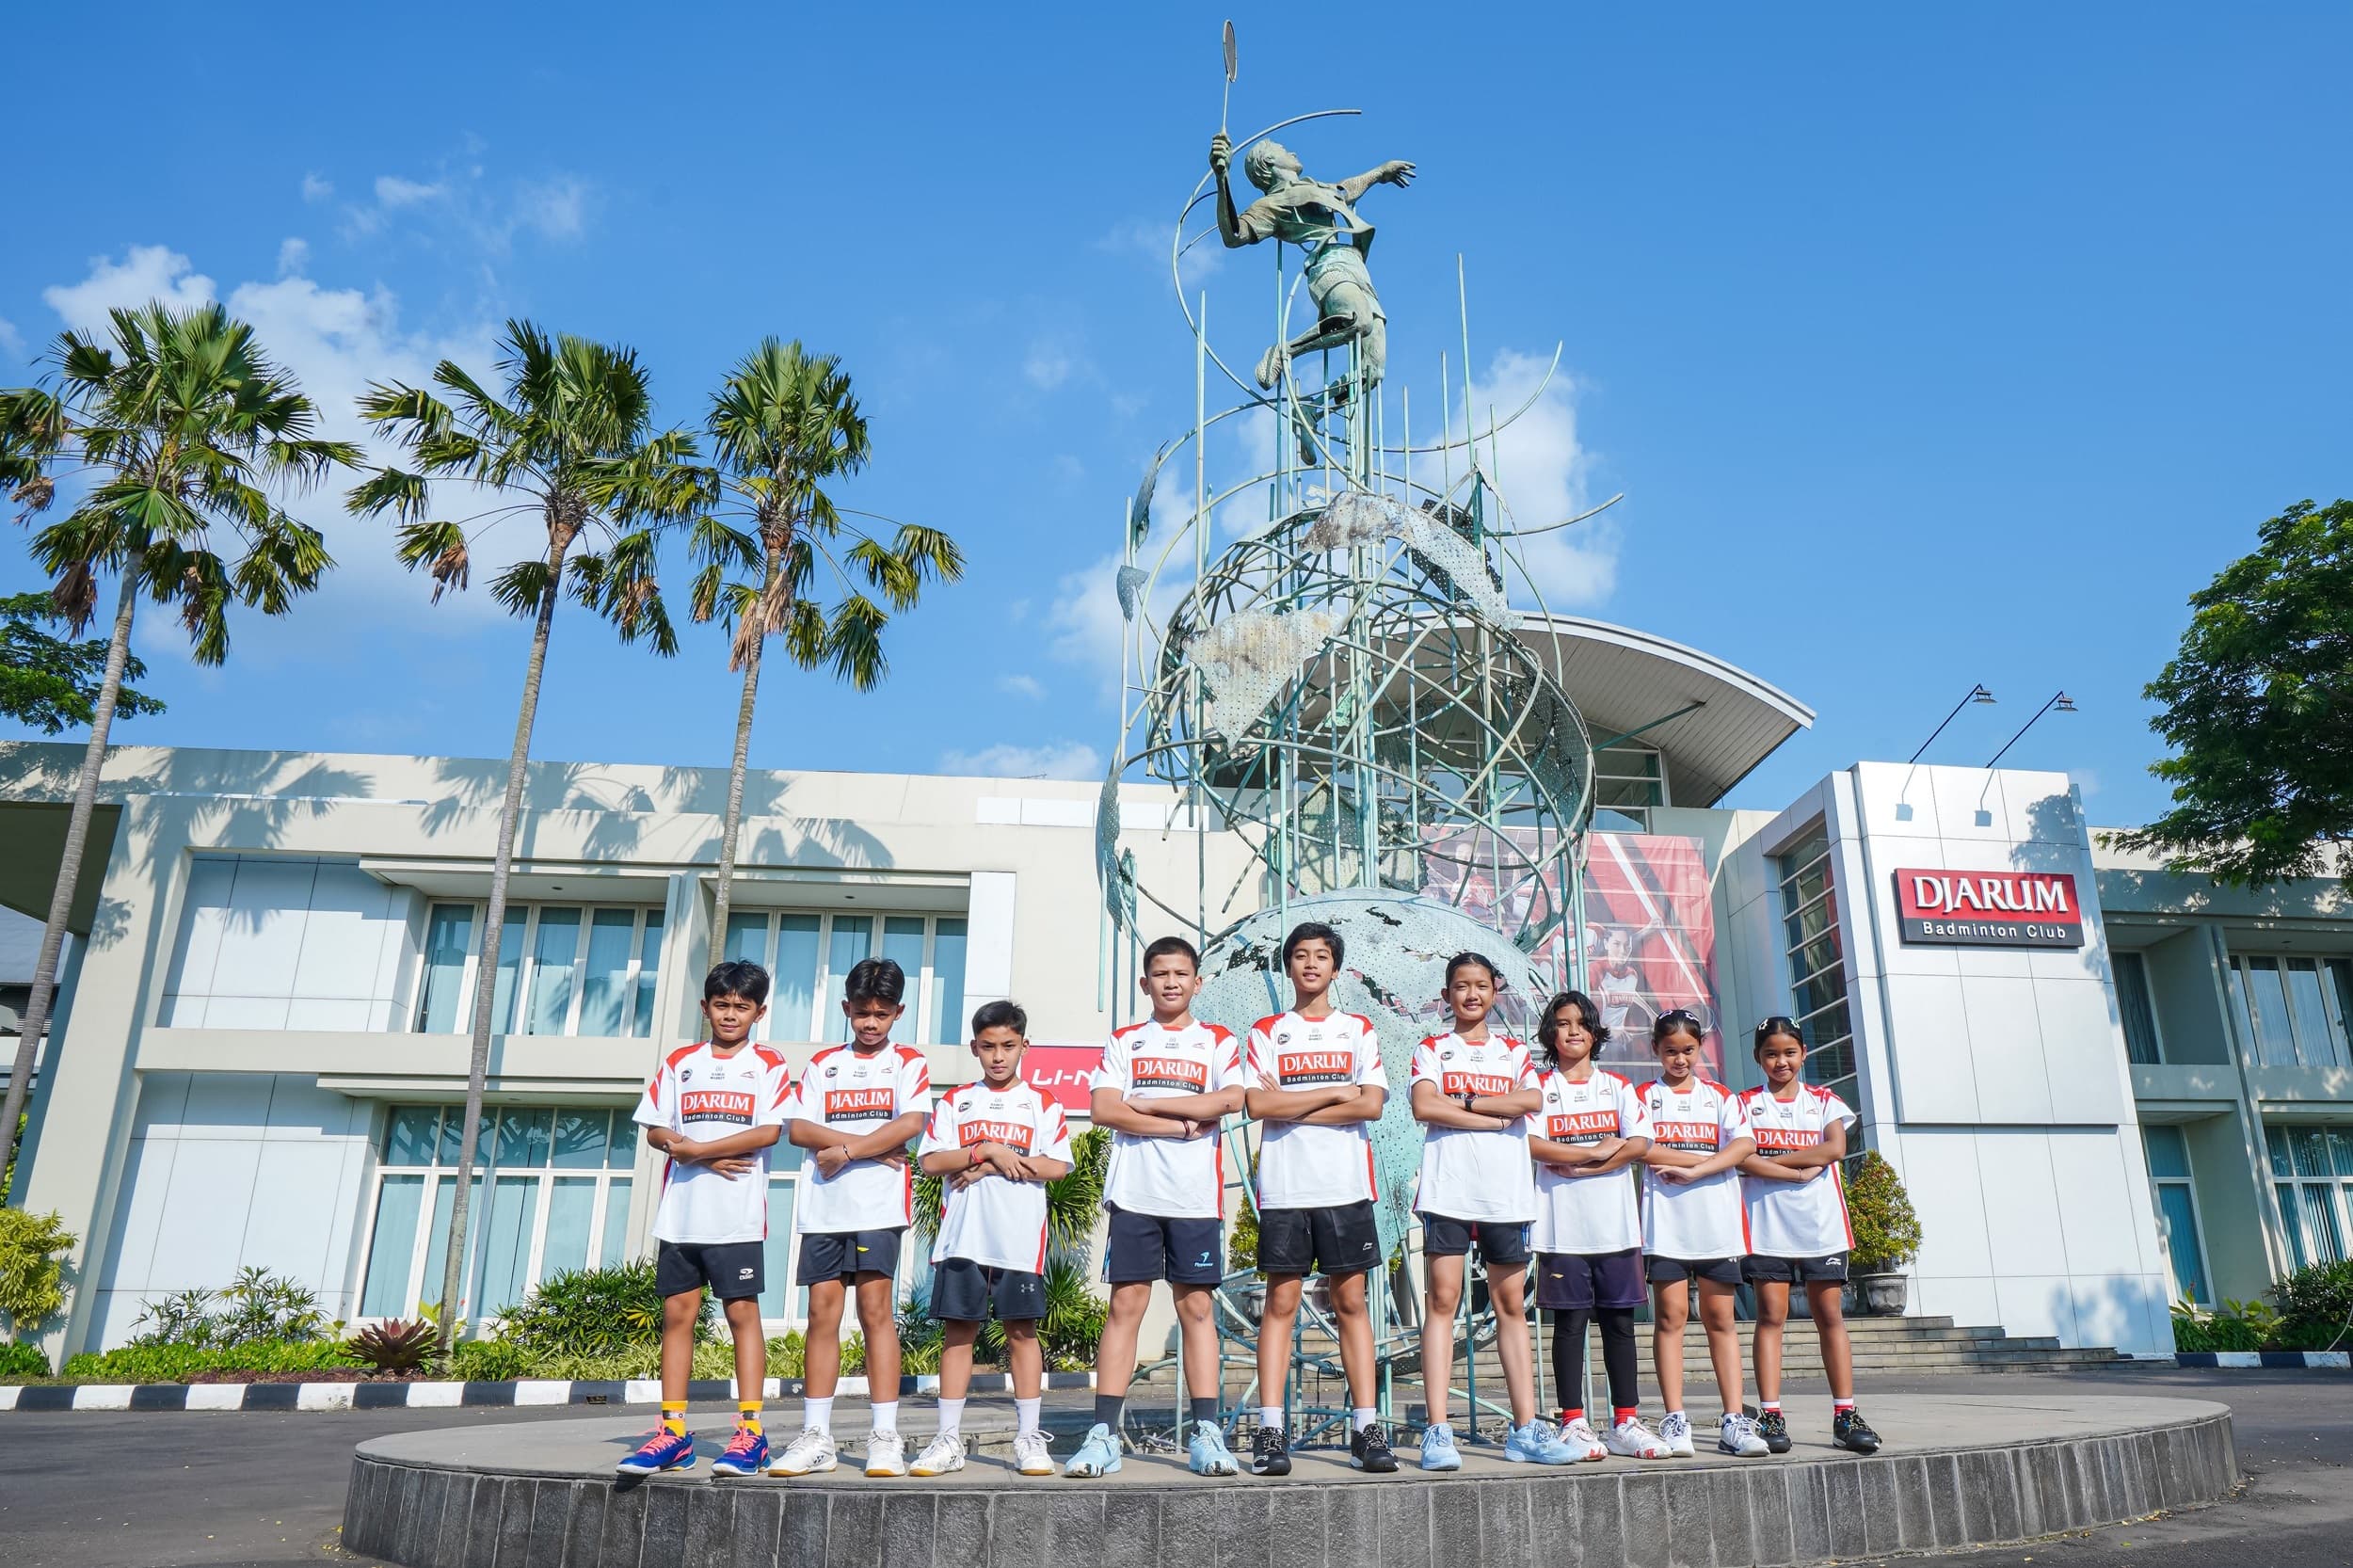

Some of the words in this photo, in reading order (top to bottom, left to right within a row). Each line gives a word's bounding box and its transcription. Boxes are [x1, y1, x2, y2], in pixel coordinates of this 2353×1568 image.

[1913, 876, 2069, 913] DJARUM
[1923, 921, 2017, 937] Badminton
[2026, 925, 2066, 938] Club
[1137, 1060, 1204, 1080] DJARUM
[1283, 1054, 1348, 1072] DJARUM
[1032, 1068, 1094, 1085] LI-N
[1287, 1074, 1329, 1083] Badminton
[1448, 1075, 1510, 1094] DJARUM
[1182, 1081, 1200, 1091] Club
[683, 1094, 750, 1112] DJARUM
[683, 1112, 724, 1121] Badminton
[726, 1114, 746, 1123] Club
[1553, 1113, 1615, 1132] DJARUM
[964, 1122, 1028, 1144] DJARUM
[1556, 1133, 1597, 1143] Badminton
[1657, 1124, 1716, 1140] DJARUM
[1757, 1131, 1818, 1146] DJARUM
